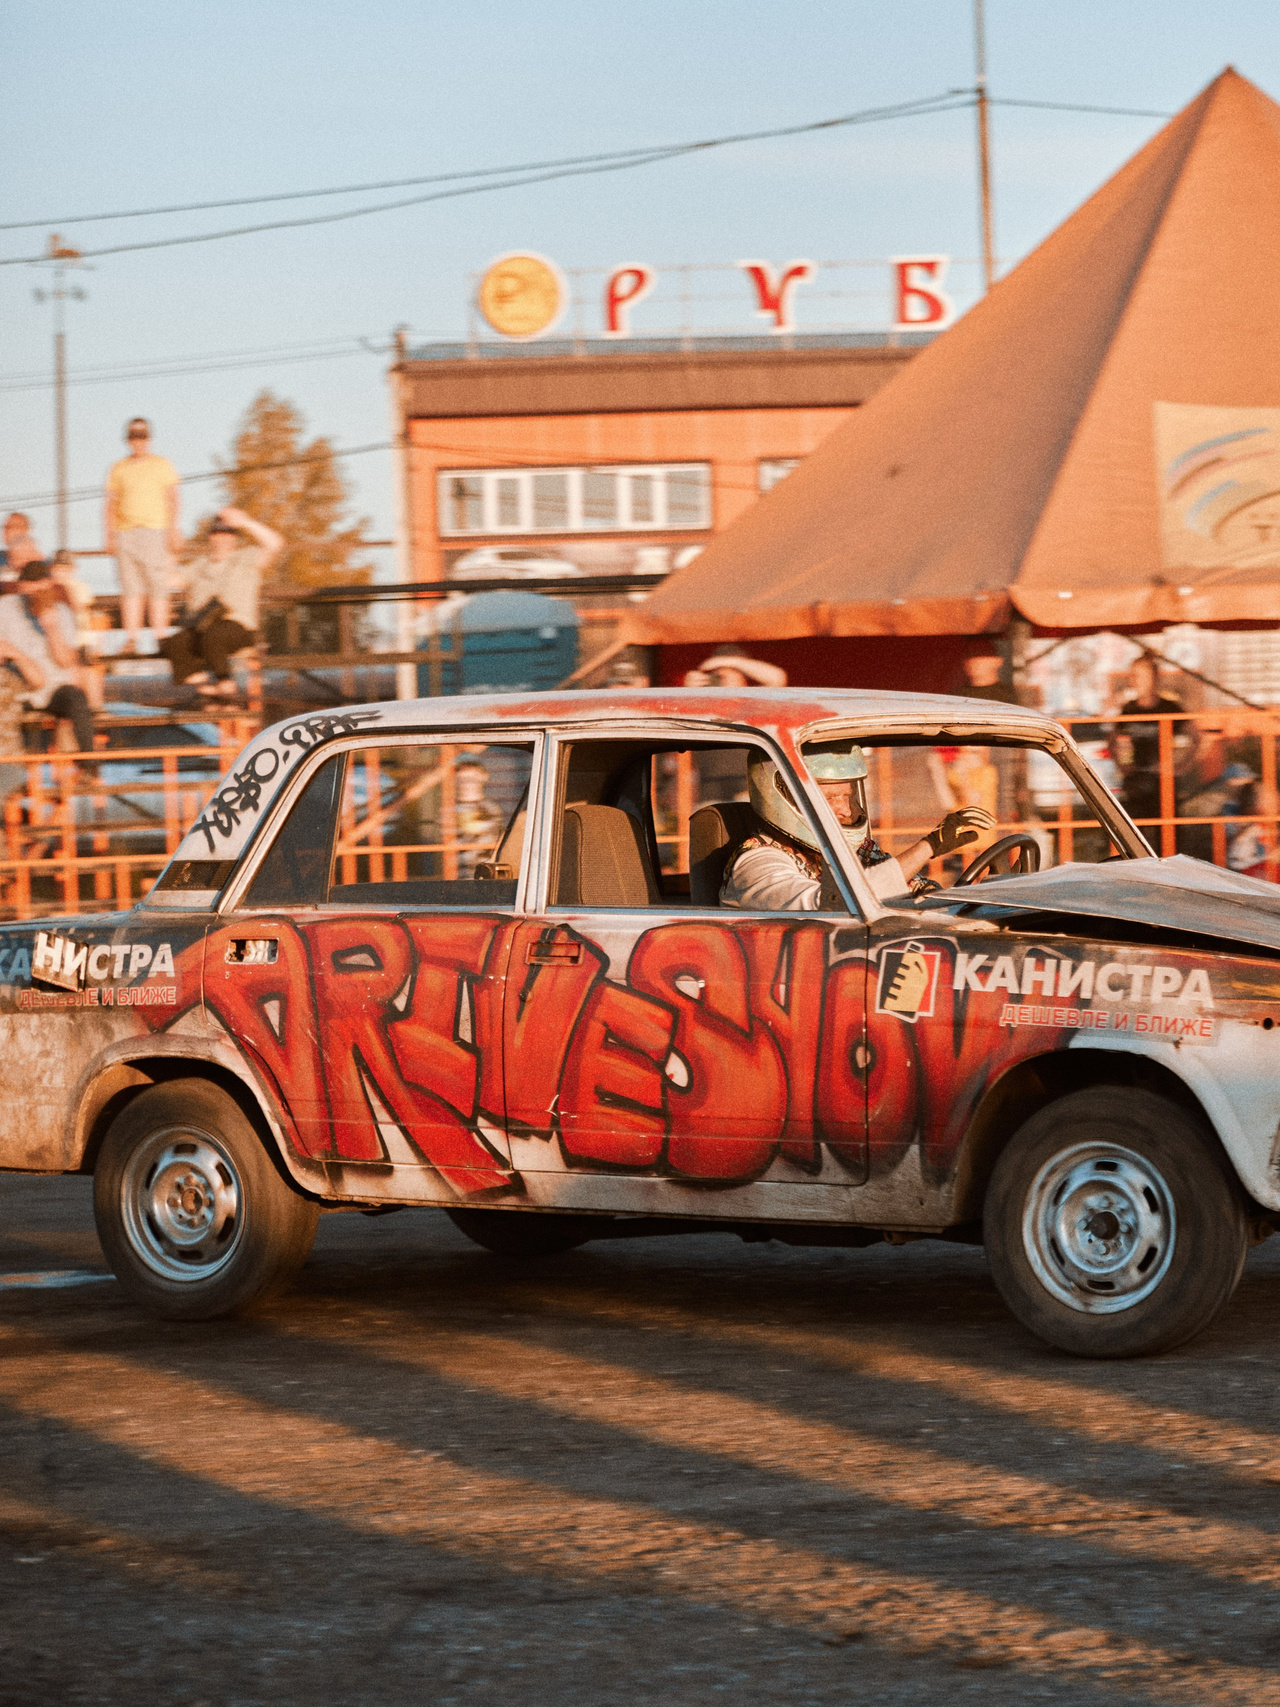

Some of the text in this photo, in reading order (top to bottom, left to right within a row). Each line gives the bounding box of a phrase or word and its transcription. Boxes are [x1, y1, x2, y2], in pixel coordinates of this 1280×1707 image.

[102, 988, 113, 1006] И
[117, 986, 177, 1006] БЛИЖЕ
[953, 953, 1215, 1008] КАНИСТРА
[1000, 1003, 1214, 1038] ДЕШЕВЛЕ И БЛИЖЕ
